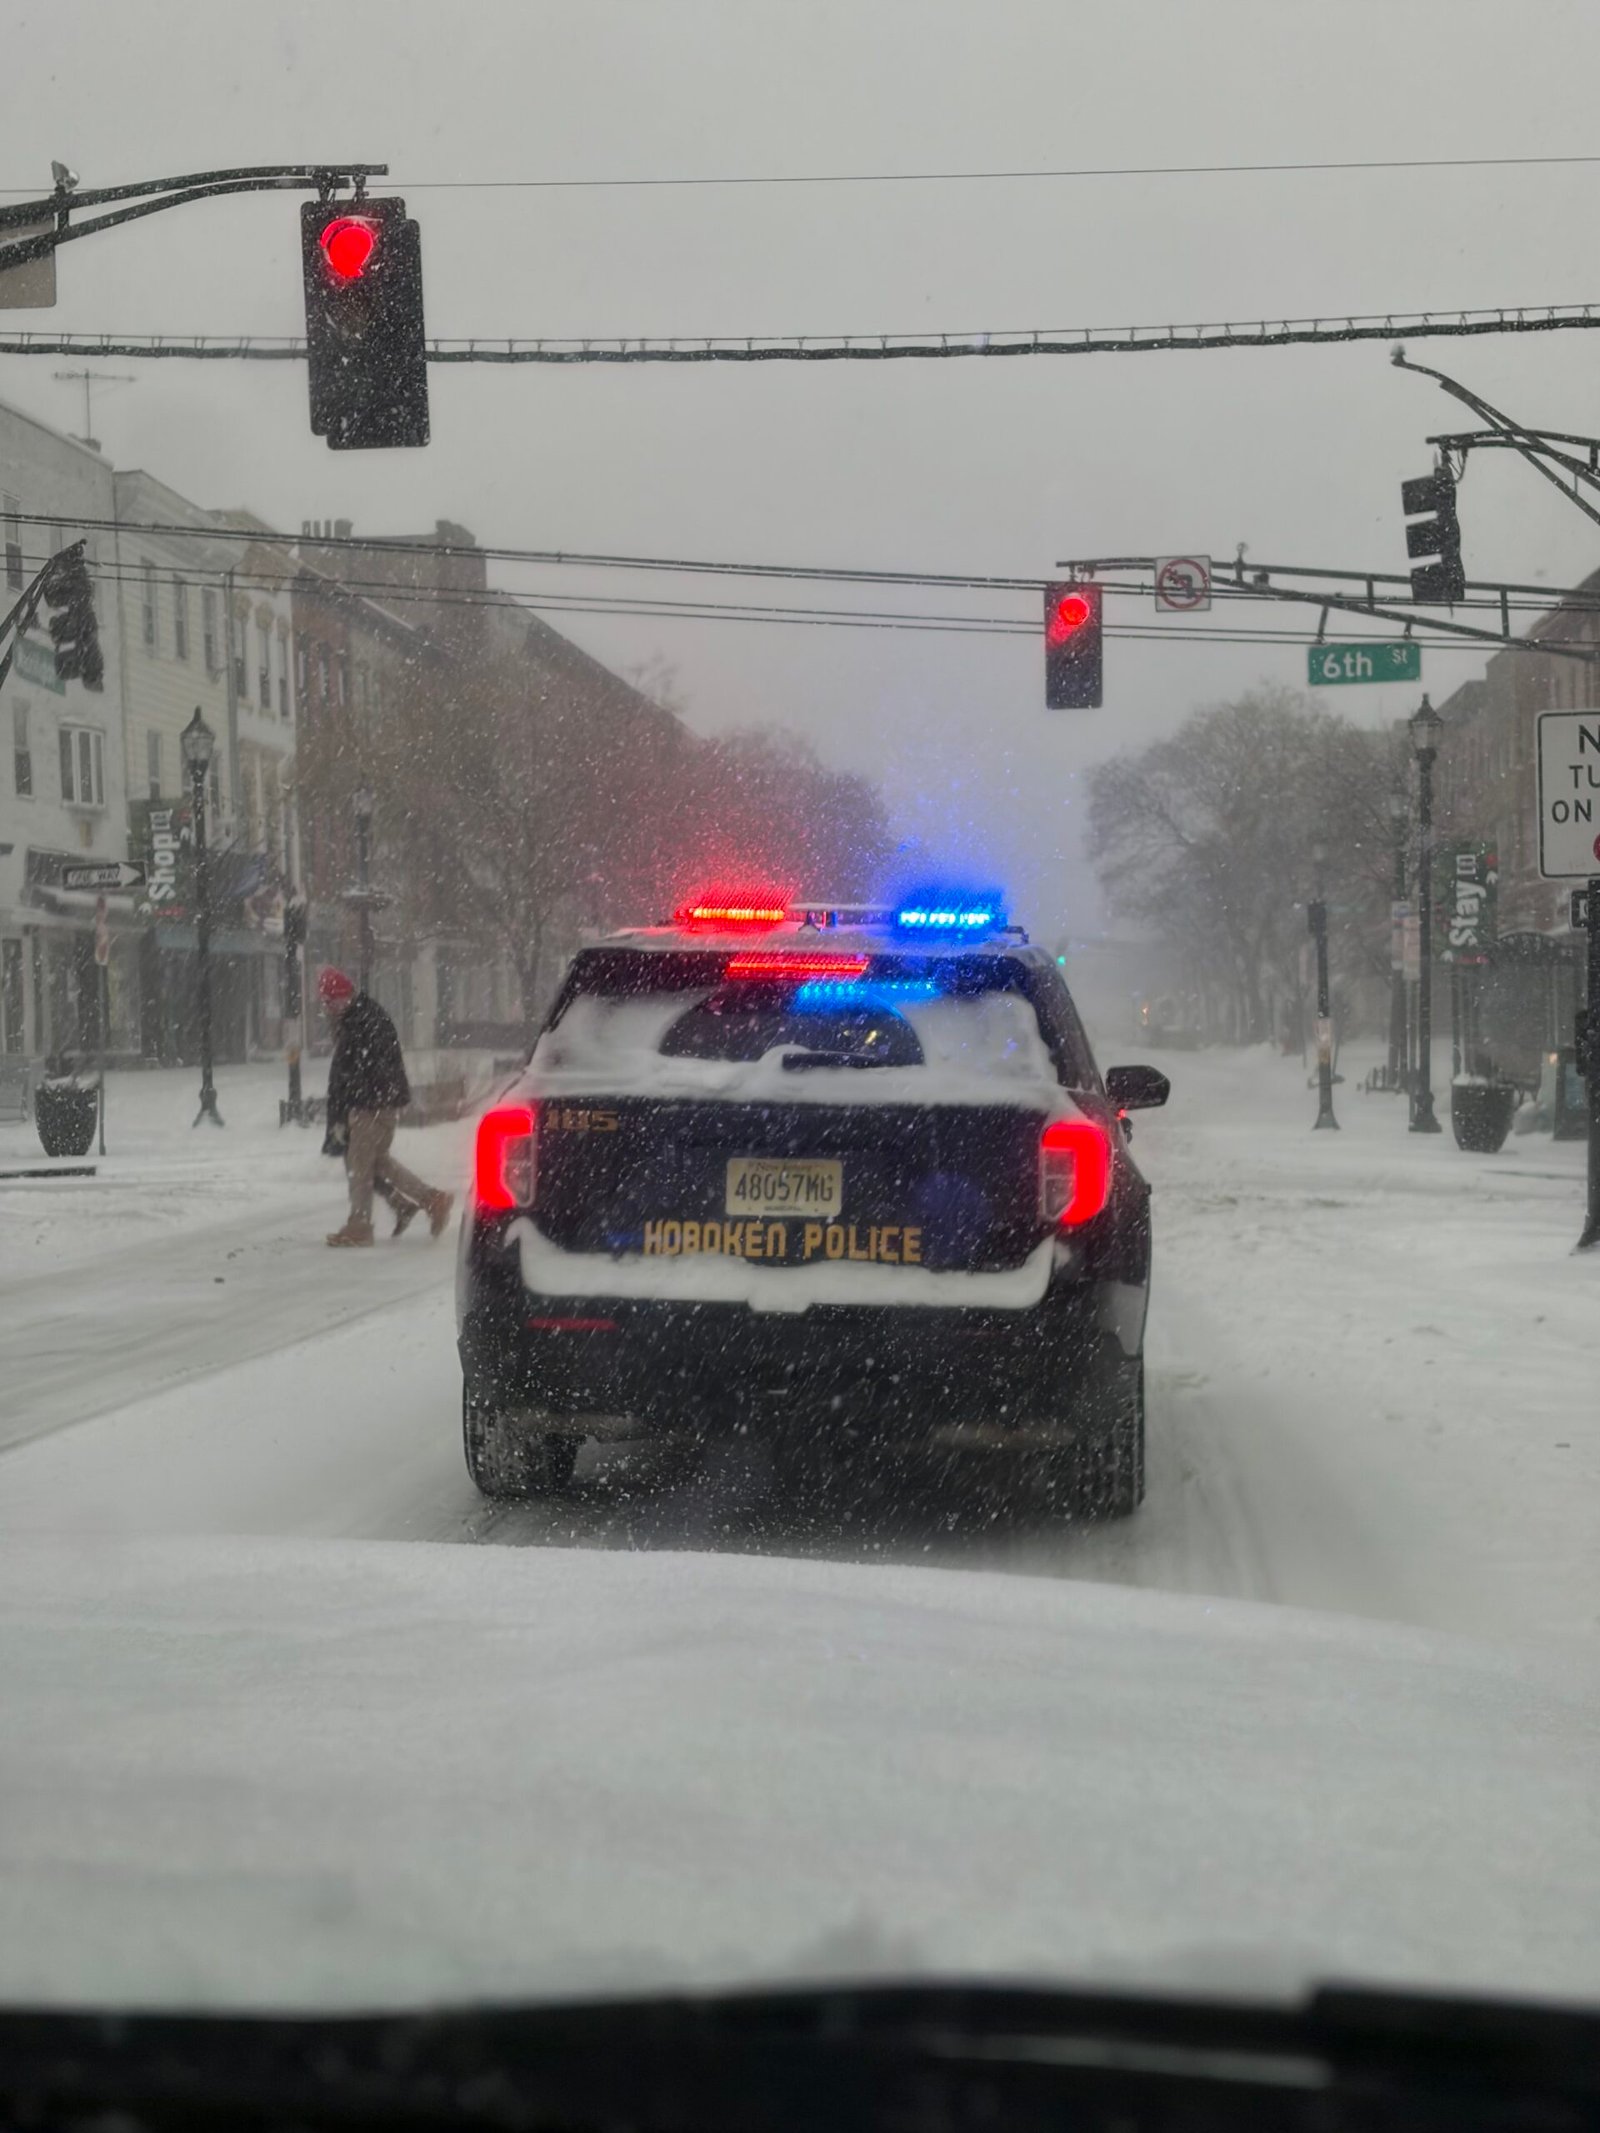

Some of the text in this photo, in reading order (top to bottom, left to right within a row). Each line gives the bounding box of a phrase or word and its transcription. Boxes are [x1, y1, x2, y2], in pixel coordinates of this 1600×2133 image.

[1323, 648, 1408, 678] 6th St
[1579, 724, 1600, 754] N
[1568, 764, 1600, 789] TU
[1552, 799, 1592, 824] ON
[148, 833, 181, 901] Shop
[1449, 880, 1487, 946] Stay
[644, 1220, 922, 1262] HOBOKEN POLICE
